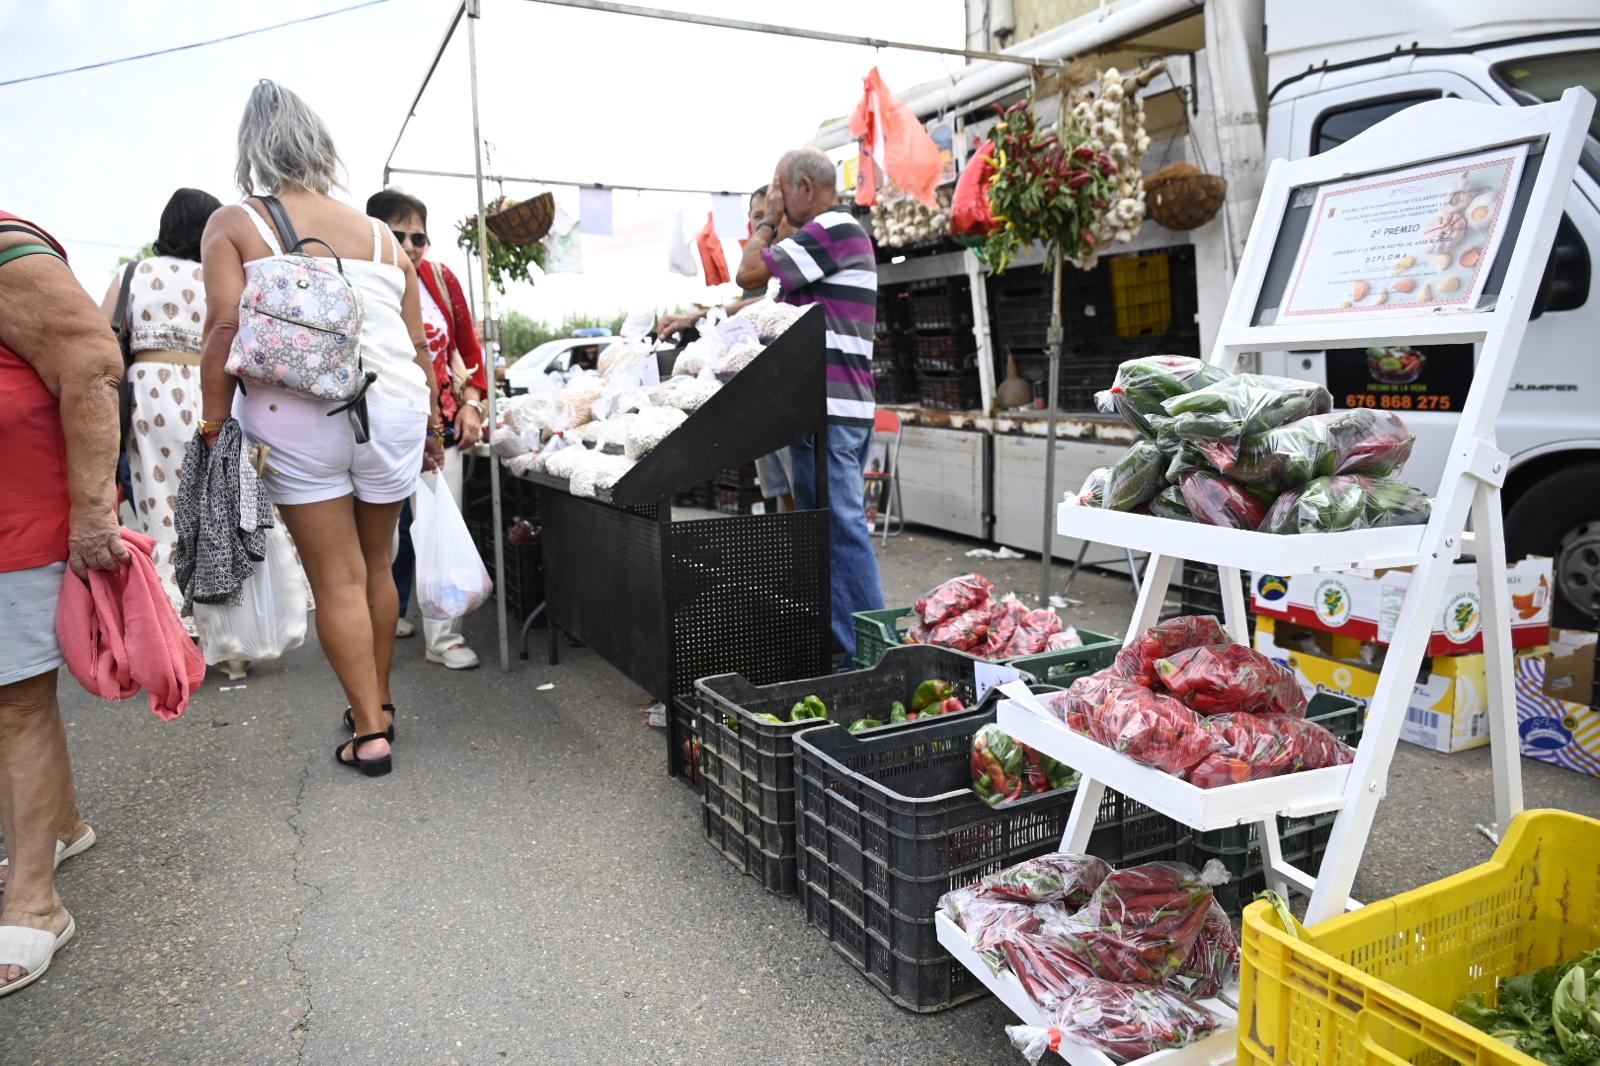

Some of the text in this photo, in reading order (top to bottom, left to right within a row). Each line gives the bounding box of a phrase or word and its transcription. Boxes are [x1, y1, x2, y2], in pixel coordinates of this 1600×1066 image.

[1384, 224, 1420, 237] PREMIO
[1400, 383, 1408, 392] LA
[1508, 383, 1578, 392] JUMPER
[1346, 394, 1451, 409] 676 868 275
